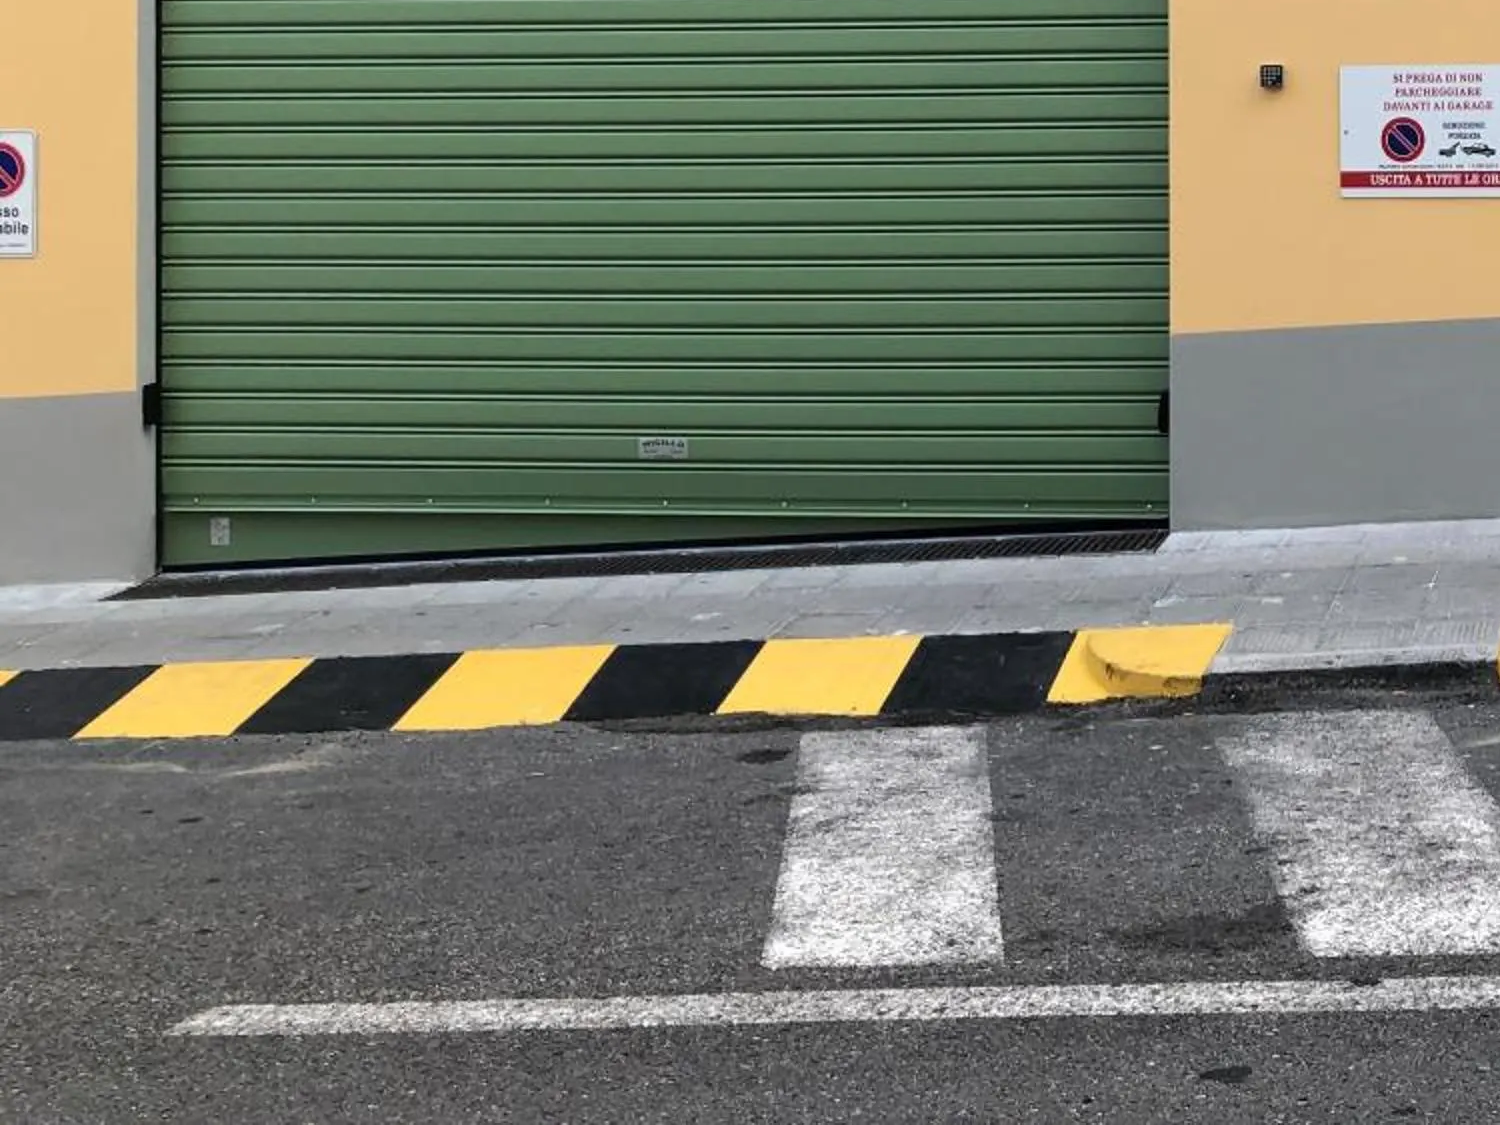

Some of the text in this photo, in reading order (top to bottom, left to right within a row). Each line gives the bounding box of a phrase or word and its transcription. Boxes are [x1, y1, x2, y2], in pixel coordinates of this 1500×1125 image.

[1393, 72, 1483, 83] SI PREGA DI NON
[1395, 86, 1482, 97] PARCHEGGIARE
[1383, 100, 1494, 111] DAVANTI AI GARAGE
[1370, 174, 1412, 186] USCITA
[1414, 174, 1424, 186] A
[1425, 174, 1461, 186] TUTTE
[1464, 174, 1480, 186] LE
